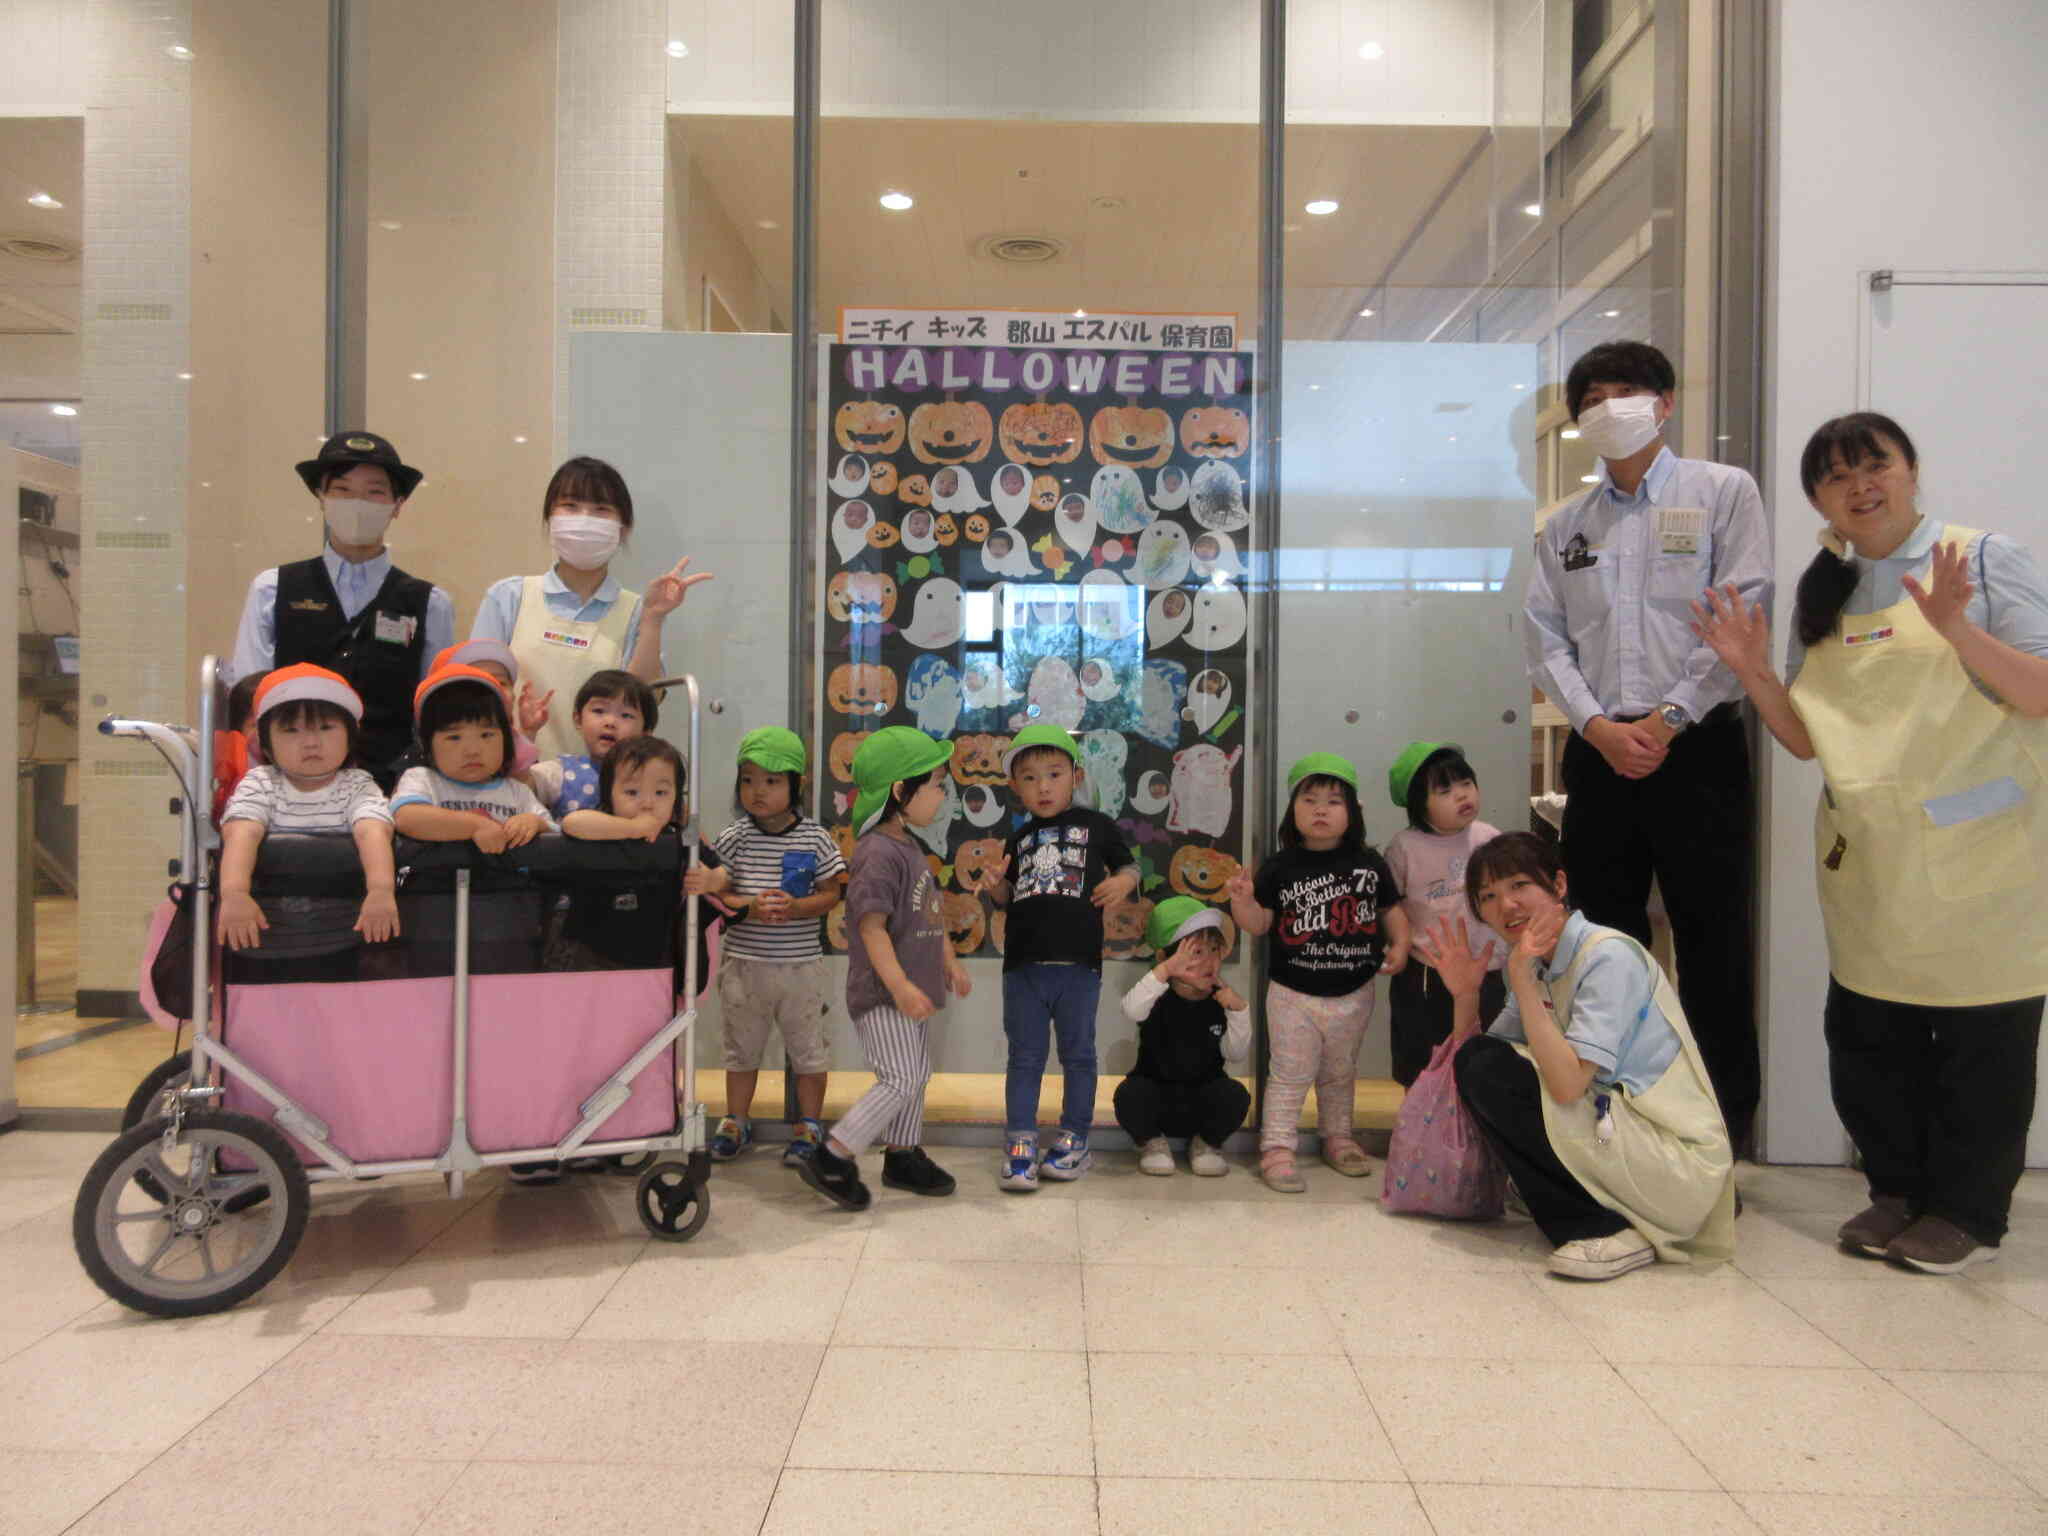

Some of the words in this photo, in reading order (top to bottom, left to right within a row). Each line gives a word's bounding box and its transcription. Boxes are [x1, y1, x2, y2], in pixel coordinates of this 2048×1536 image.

[848, 318, 914, 341] ニチイ
[928, 316, 987, 338] キッズ
[1007, 320, 1055, 344] 郡山
[1063, 320, 1152, 342] エスパル
[1161, 325, 1233, 349] 保育園
[850, 349, 1237, 395] HALLOWEEN
